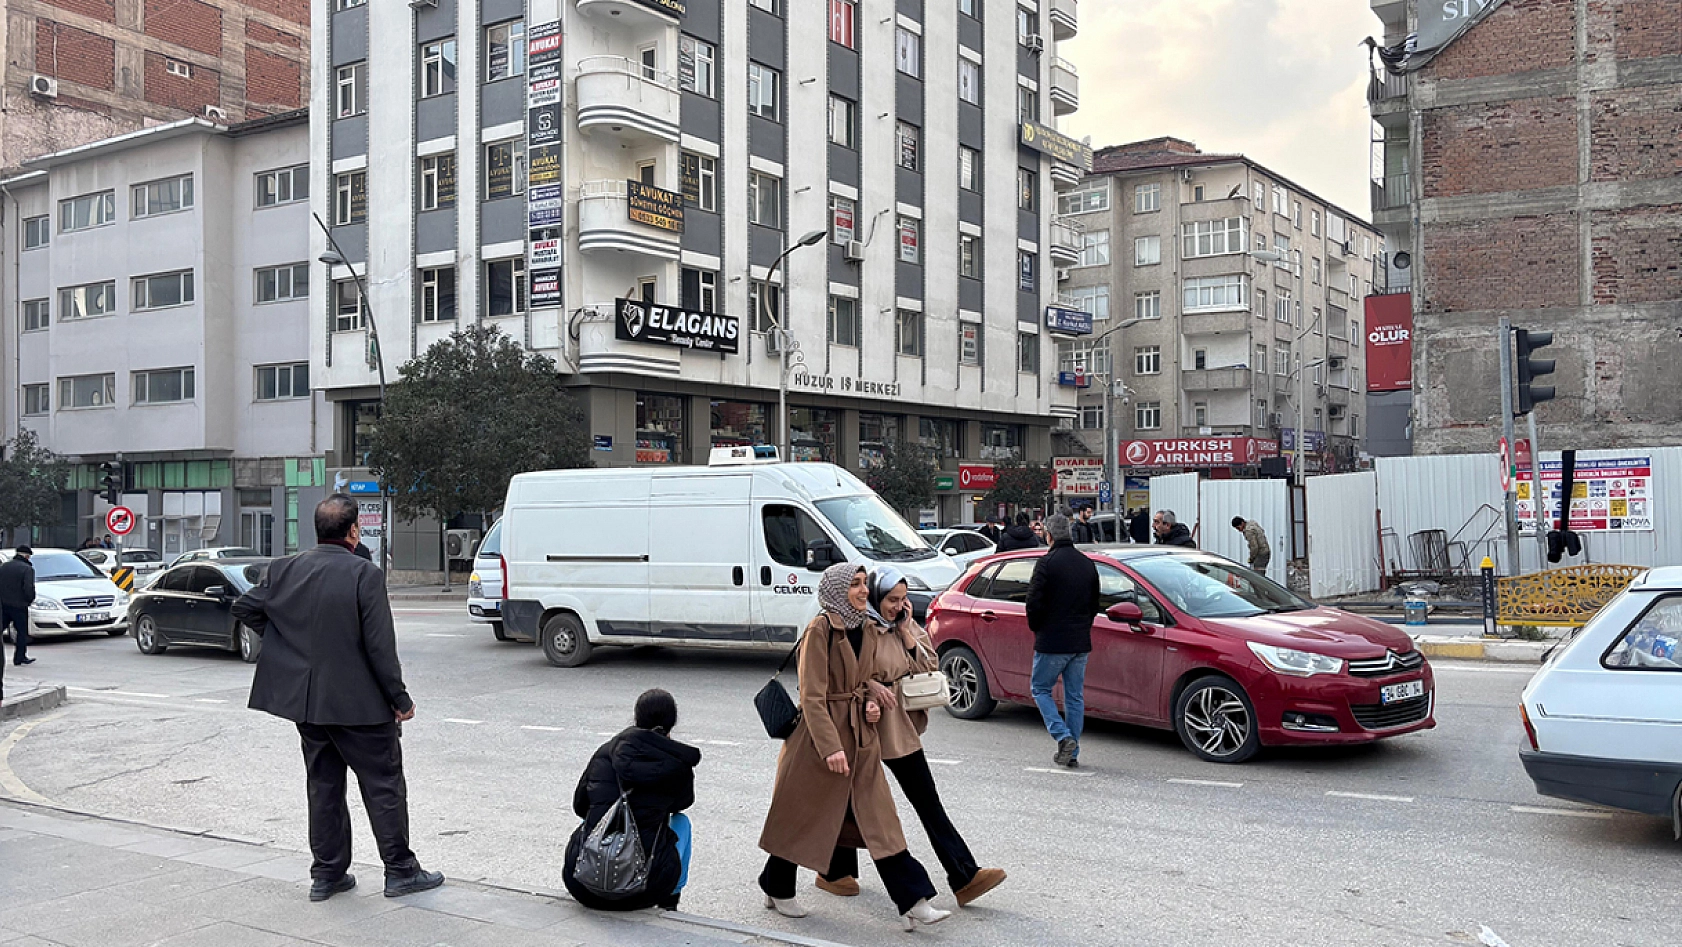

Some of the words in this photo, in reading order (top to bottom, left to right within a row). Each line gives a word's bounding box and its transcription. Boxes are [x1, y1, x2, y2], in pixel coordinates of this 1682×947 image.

[530, 35, 559, 52] AVUKAT
[640, 184, 674, 204] AVUKAT
[648, 306, 738, 339] ELAGANS
[1369, 329, 1410, 342] OLUR
[1152, 440, 1232, 452] TURKISH
[1154, 452, 1234, 464] AIRLINES
[1622, 518, 1651, 526] NOVA
